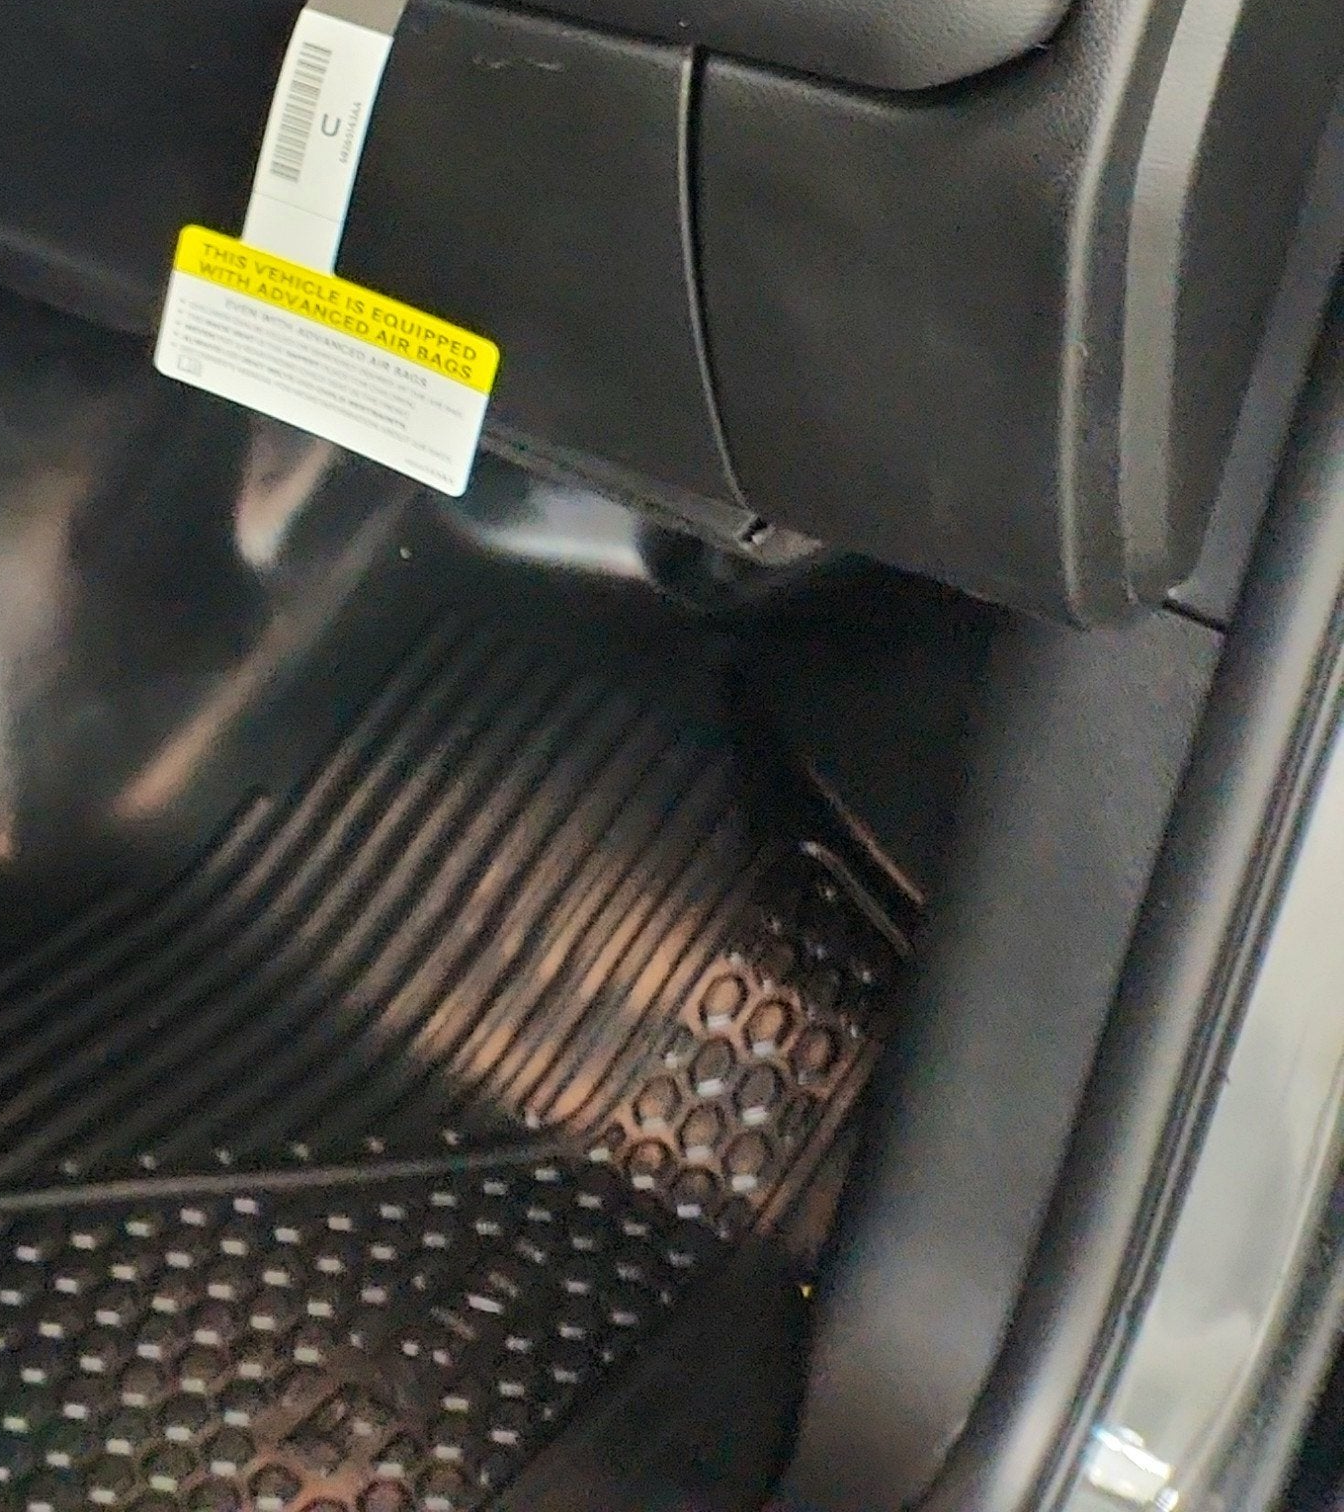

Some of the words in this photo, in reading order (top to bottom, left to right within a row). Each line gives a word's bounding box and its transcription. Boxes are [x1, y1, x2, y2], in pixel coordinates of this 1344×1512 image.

[200, 262, 250, 290] WITH
[257, 282, 369, 337] ADVANCED
[376, 330, 410, 353] AIR
[416, 345, 472, 381] BAGS
[204, 242, 246, 269] THIS
[255, 262, 338, 304] VEHICLE
[346, 296, 364, 315] IS
[371, 307, 477, 362] EQUIPPED
[225, 298, 257, 322] EVEN
[262, 312, 293, 332] WITH
[298, 321, 365, 362] ADVANCED
[369, 349, 390, 372] AIR
[394, 360, 428, 388] BAGS
